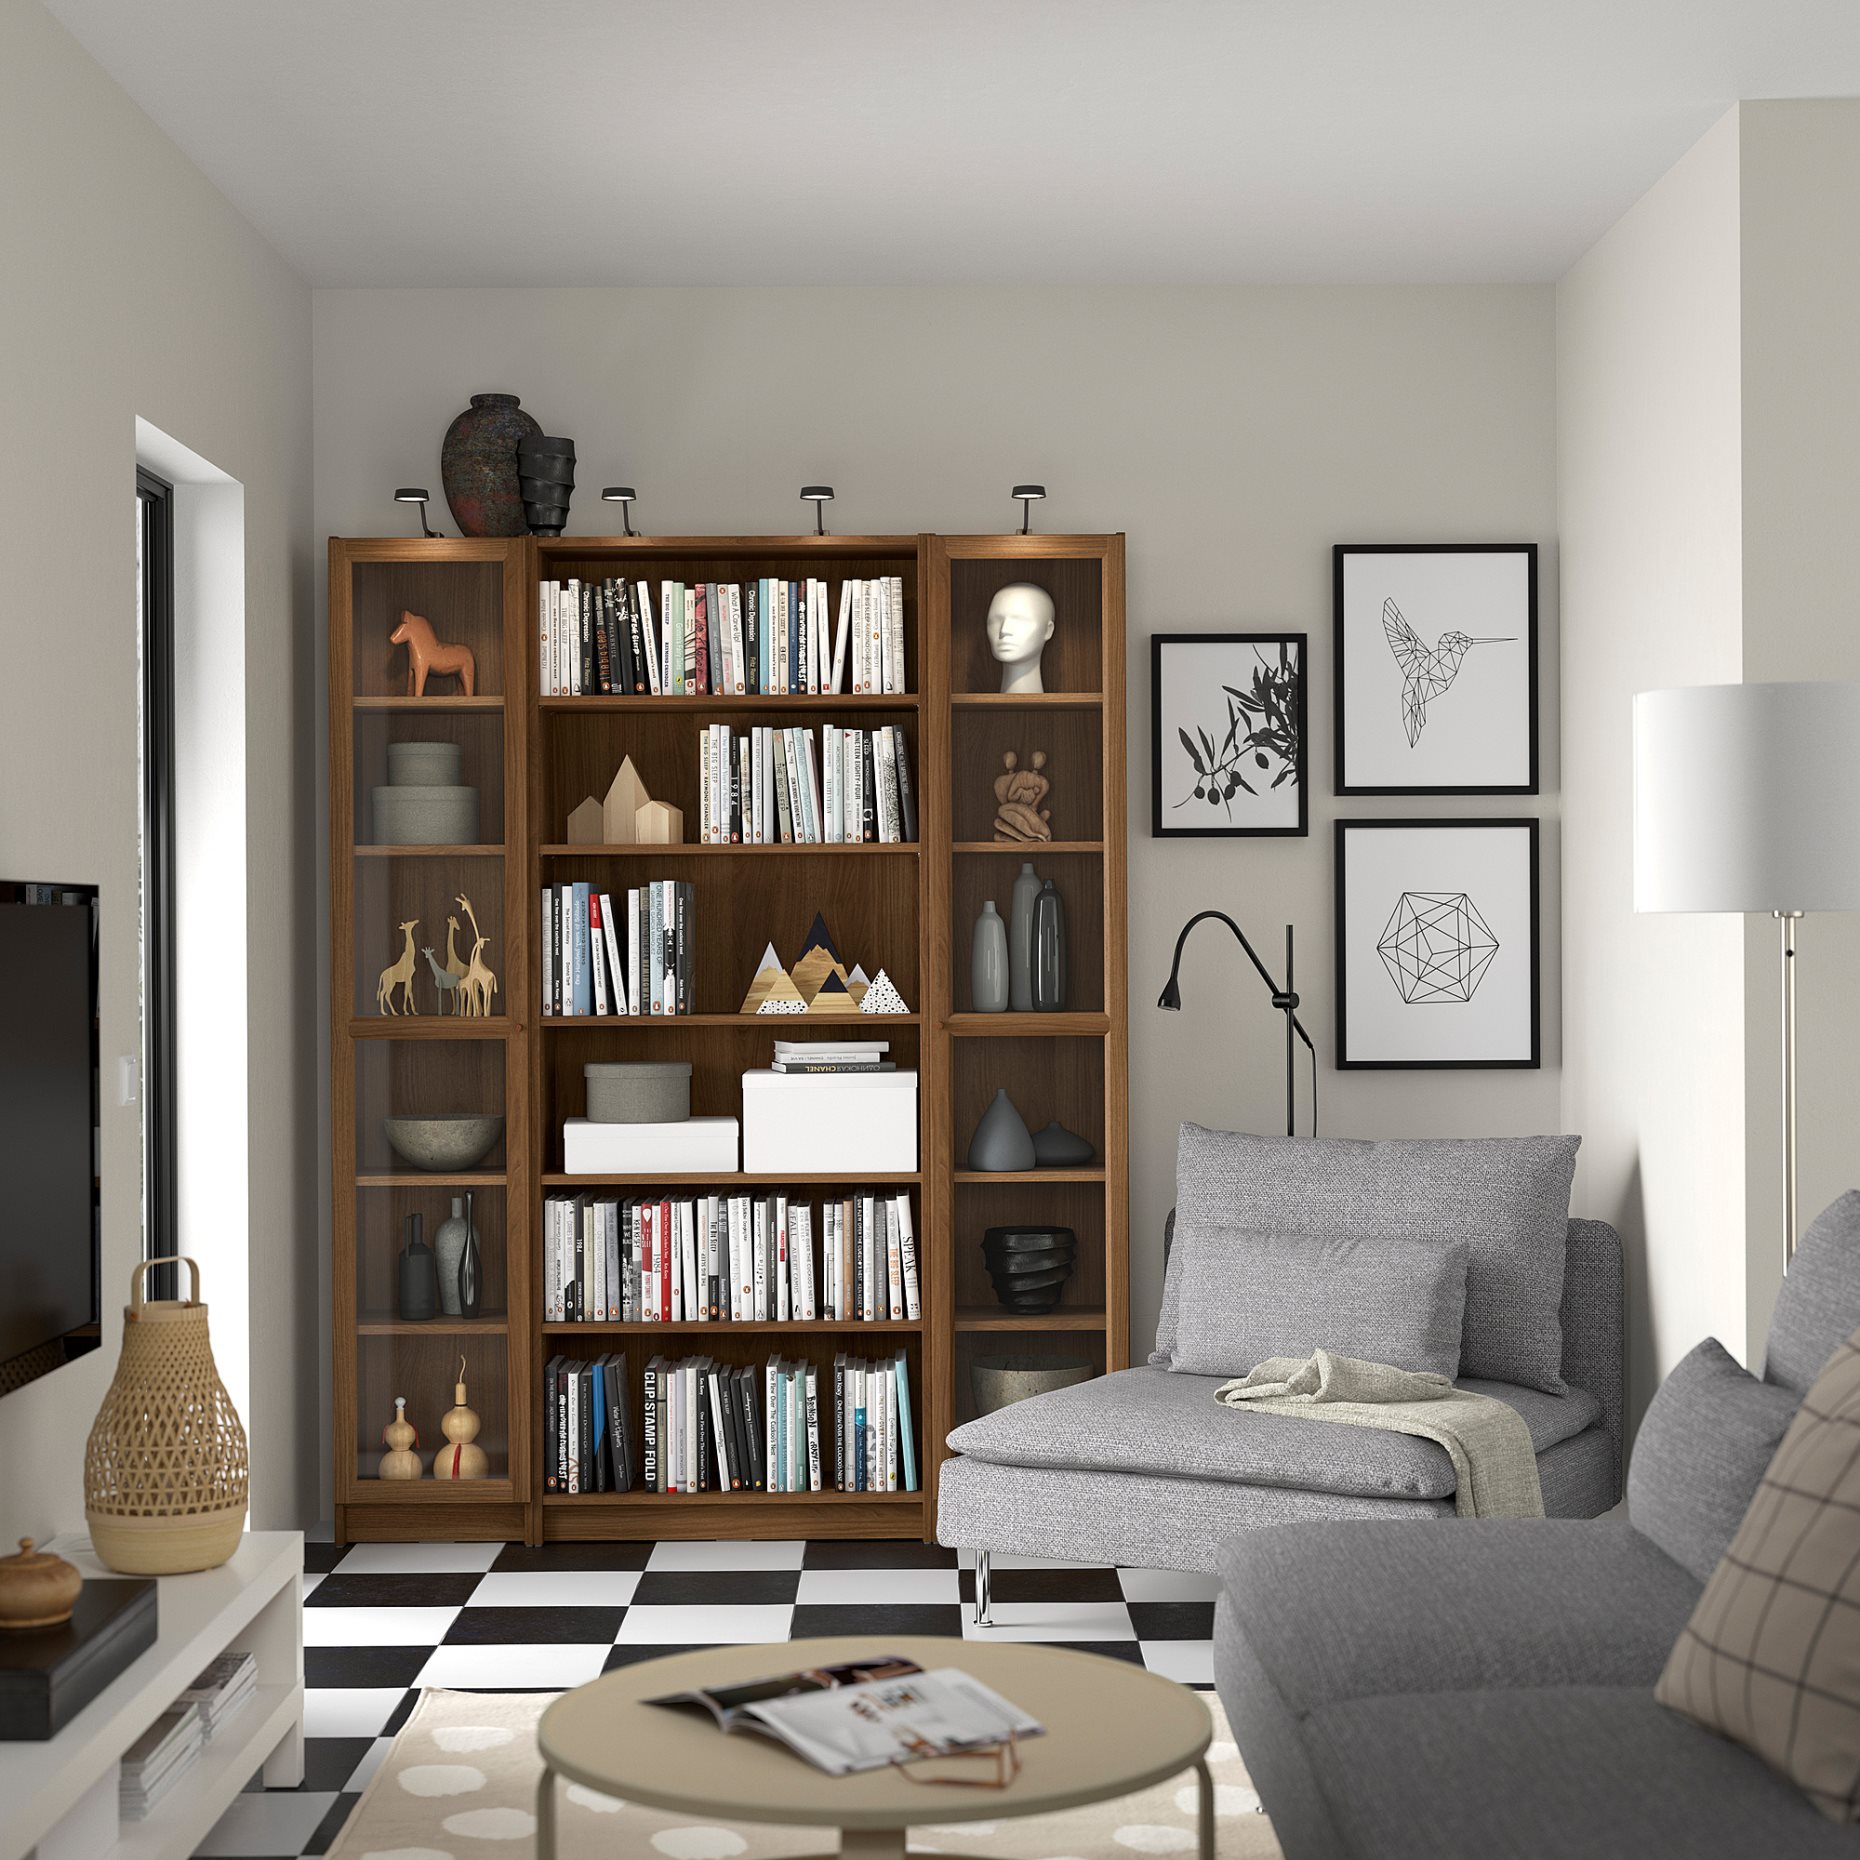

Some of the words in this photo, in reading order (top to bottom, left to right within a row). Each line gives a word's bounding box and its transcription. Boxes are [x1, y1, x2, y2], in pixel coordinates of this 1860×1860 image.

[656, 956, 662, 965] OF
[889, 1248, 898, 1258] THE
[890, 1260, 899, 1268] BIG
[903, 1236, 916, 1272] SPEAK
[890, 1270, 900, 1286] SLEEP
[644, 1372, 655, 1399] CLIP
[644, 1403, 655, 1445] STAMP
[807, 1396, 817, 1428] BRONSON
[614, 1427, 622, 1448] Elephants
[644, 1450, 655, 1480] FOLD
